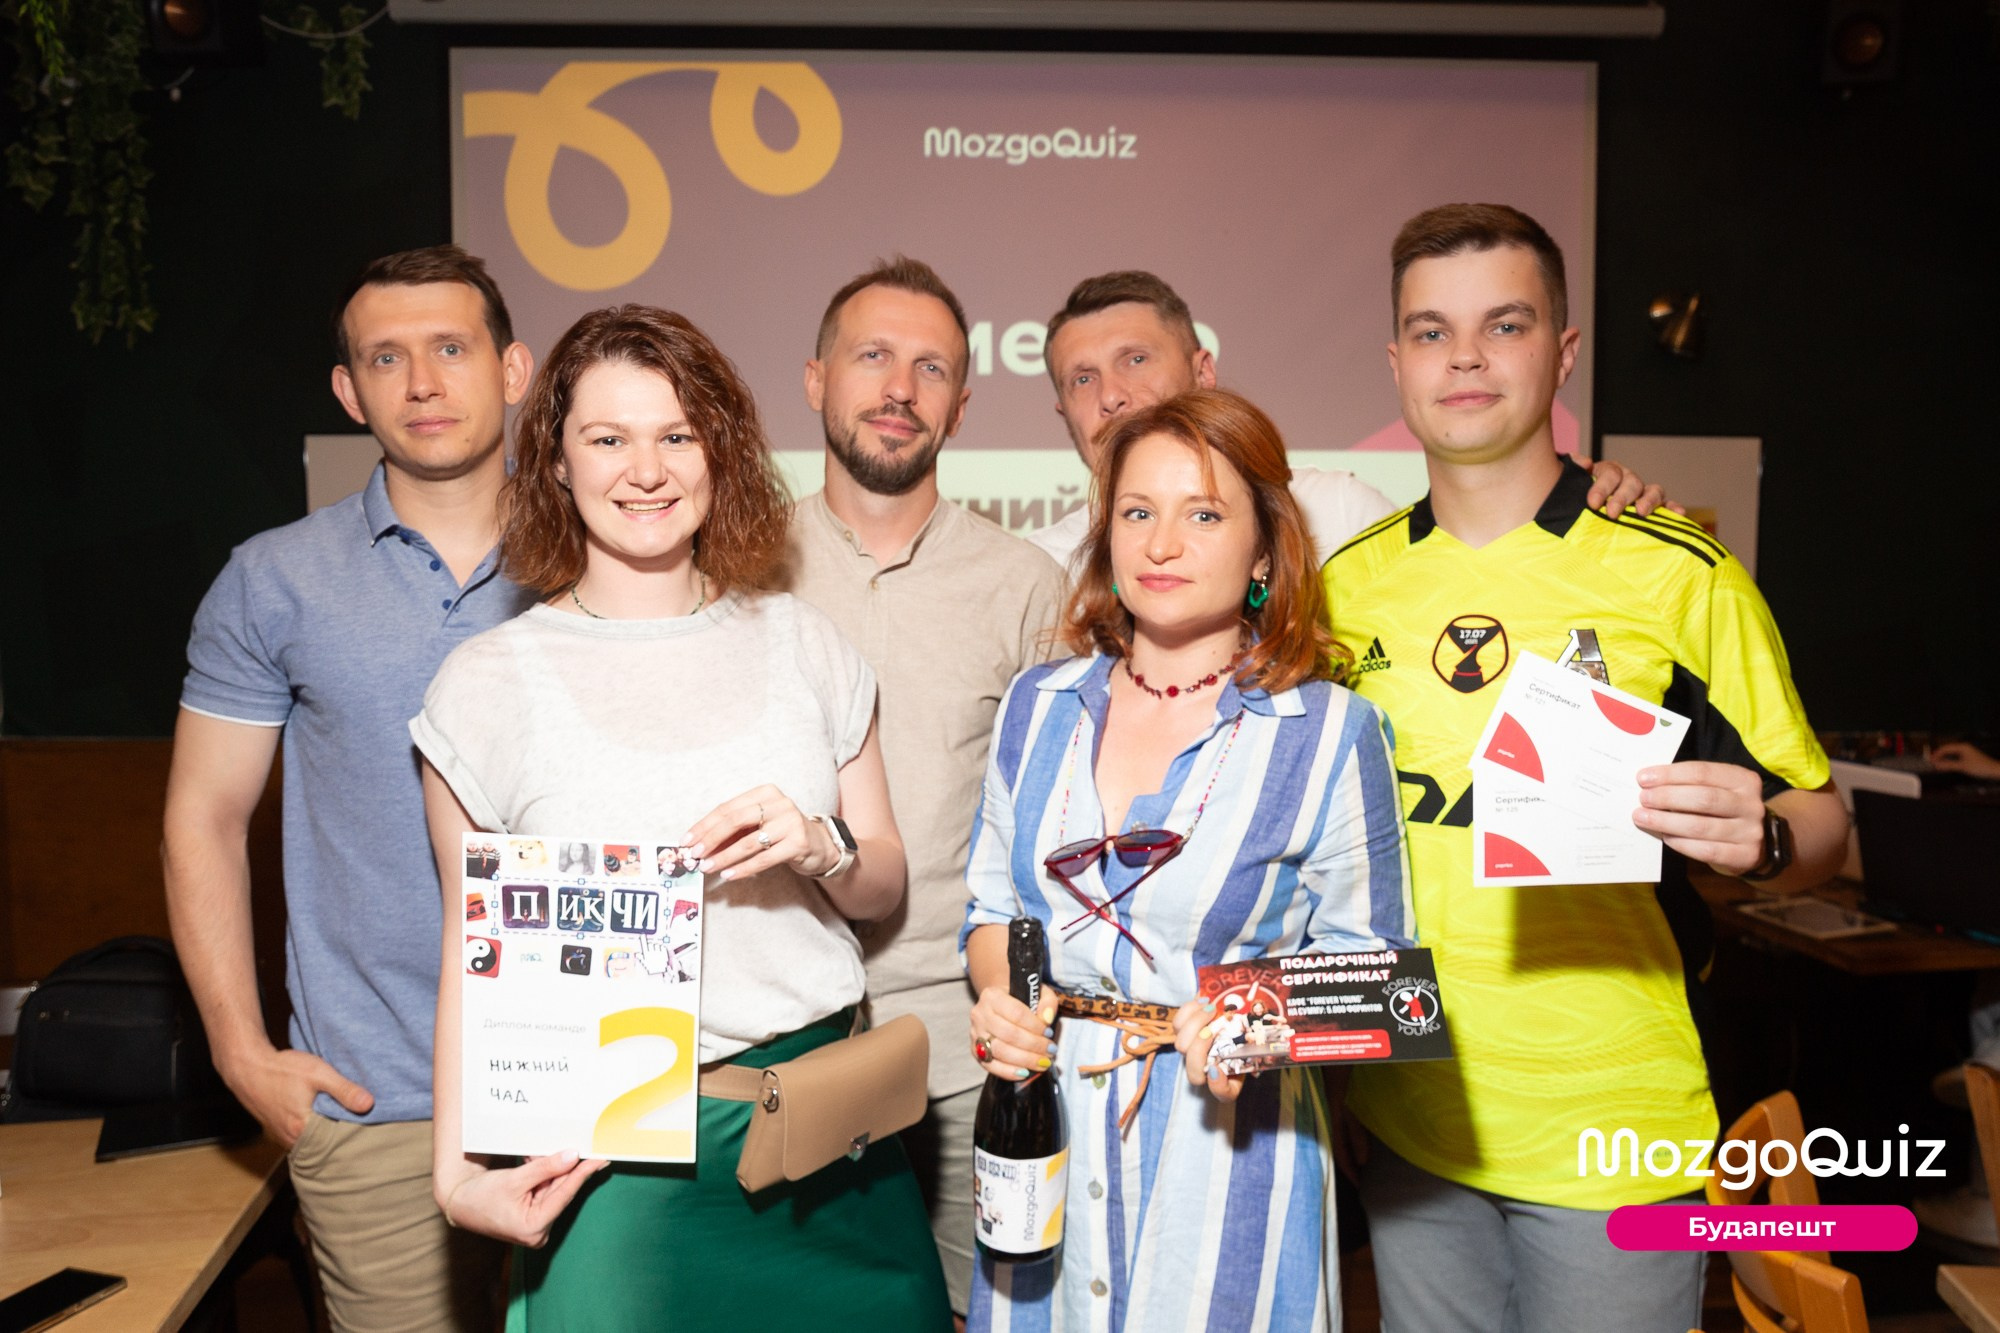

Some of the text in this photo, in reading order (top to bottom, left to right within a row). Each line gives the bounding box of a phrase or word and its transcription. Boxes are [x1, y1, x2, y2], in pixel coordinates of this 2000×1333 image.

[924, 126, 1137, 165] MozgoQuiz
[1459, 629, 1487, 639] 17.07
[1358, 659, 1391, 673] adidas
[1529, 683, 1581, 710] Сертификат
[1280, 950, 1399, 970] ПОДАРОЧНЫЙ
[1281, 969, 1391, 986] СЕРТИФИКАТ
[1381, 976, 1438, 996] FOREVER
[483, 1018, 587, 1033] Диплом команде
[1398, 1020, 1441, 1037] YOUNG
[592, 1007, 695, 1158] 2
[490, 1087, 529, 1103] ЧАД
[1024, 1163, 1039, 1241] MozgoQuiz
